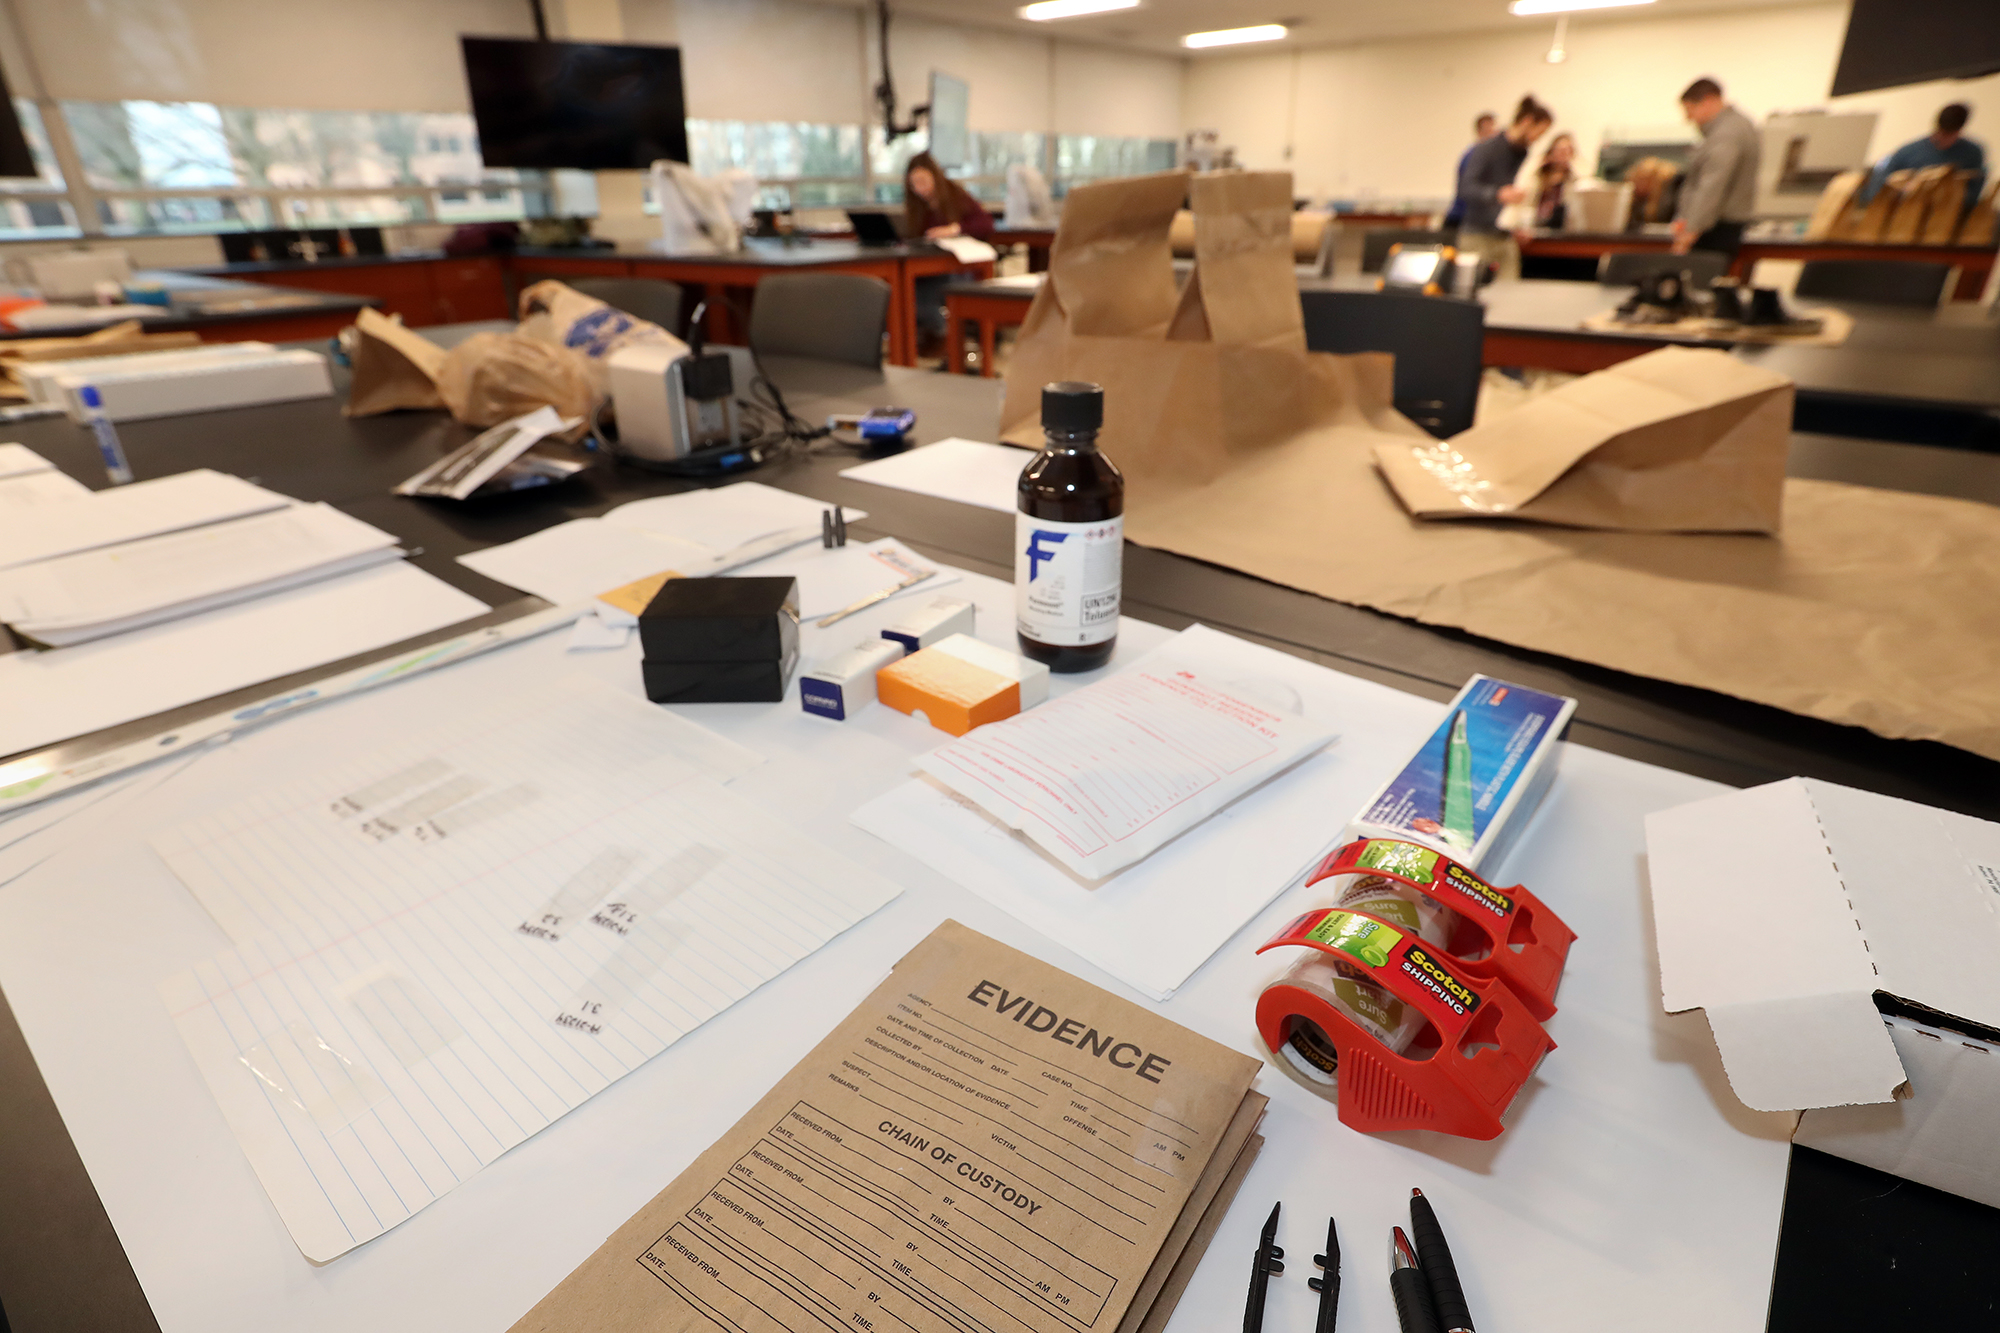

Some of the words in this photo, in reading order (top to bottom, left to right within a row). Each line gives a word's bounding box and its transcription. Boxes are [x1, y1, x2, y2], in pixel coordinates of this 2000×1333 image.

[1258, 726, 1280, 740] KIT
[1445, 876, 1505, 917] SHIPPING
[1449, 866, 1509, 909] Scotch
[1364, 902, 1398, 911] Sure
[1357, 921, 1379, 939] Sure
[1409, 950, 1475, 1006] Scotch
[1401, 961, 1465, 1015] SHIPPING
[581, 1000, 602, 1015] 3.1
[897, 1003, 912, 1014] ITEM
[907, 992, 932, 1008] AGENCY
[1358, 999, 1388, 1025] Sure
[876, 1025, 912, 1047] COLLECTED
[886, 1014, 903, 1025] DATE
[903, 1021, 917, 1032] AND
[917, 1029, 934, 1041] TIME
[933, 1036, 944, 1045] OF
[942, 1041, 985, 1065] COLLECTION
[967, 979, 1172, 1084] EVIDENCE
[1294, 1036, 1335, 1071] Scotch
[842, 1060, 872, 1078] SUSPECT
[864, 1037, 906, 1060] DESCRIPTION
[906, 1057, 932, 1074] AND/OR
[931, 1070, 965, 1090] LOCATION
[964, 1086, 976, 1095] OF
[975, 1091, 1011, 1110] EVIDENCE
[990, 1064, 1010, 1076] DATE
[828, 1073, 860, 1092] REMARKS
[1041, 1071, 1061, 1083] CASE
[1060, 1079, 1073, 1089] NO.
[1070, 1100, 1088, 1112] TIME
[776, 1125, 795, 1139] DATE
[790, 1111, 823, 1133] RECEIVED
[822, 1128, 843, 1144] FROM
[1062, 1115, 1098, 1136] OFFENSE
[991, 1133, 1017, 1152] VICTIM
[1153, 1142, 1167, 1152] AM
[1171, 1150, 1185, 1161] PM
[735, 1163, 754, 1178] DATE
[751, 1150, 784, 1172] RECEIVED
[782, 1167, 805, 1184] FROM
[877, 1120, 931, 1152] CHAIN
[930, 1147, 957, 1166] OF
[956, 1161, 1043, 1217] CUSTODY
[710, 1190, 745, 1215] RECEIVED
[742, 1209, 765, 1228] FROM
[942, 1196, 955, 1207] BY
[694, 1207, 713, 1224] DATE
[929, 1213, 950, 1229] TIME
[906, 1241, 919, 1252] BY
[645, 1252, 666, 1270] DATE
[664, 1234, 699, 1264] RECEIVED
[697, 1260, 721, 1279] FROM
[892, 1259, 913, 1277] TIME
[867, 1291, 882, 1303] BY
[1035, 1281, 1051, 1293] AM
[1055, 1292, 1071, 1306] PM
[852, 1312, 874, 1332] TIME
